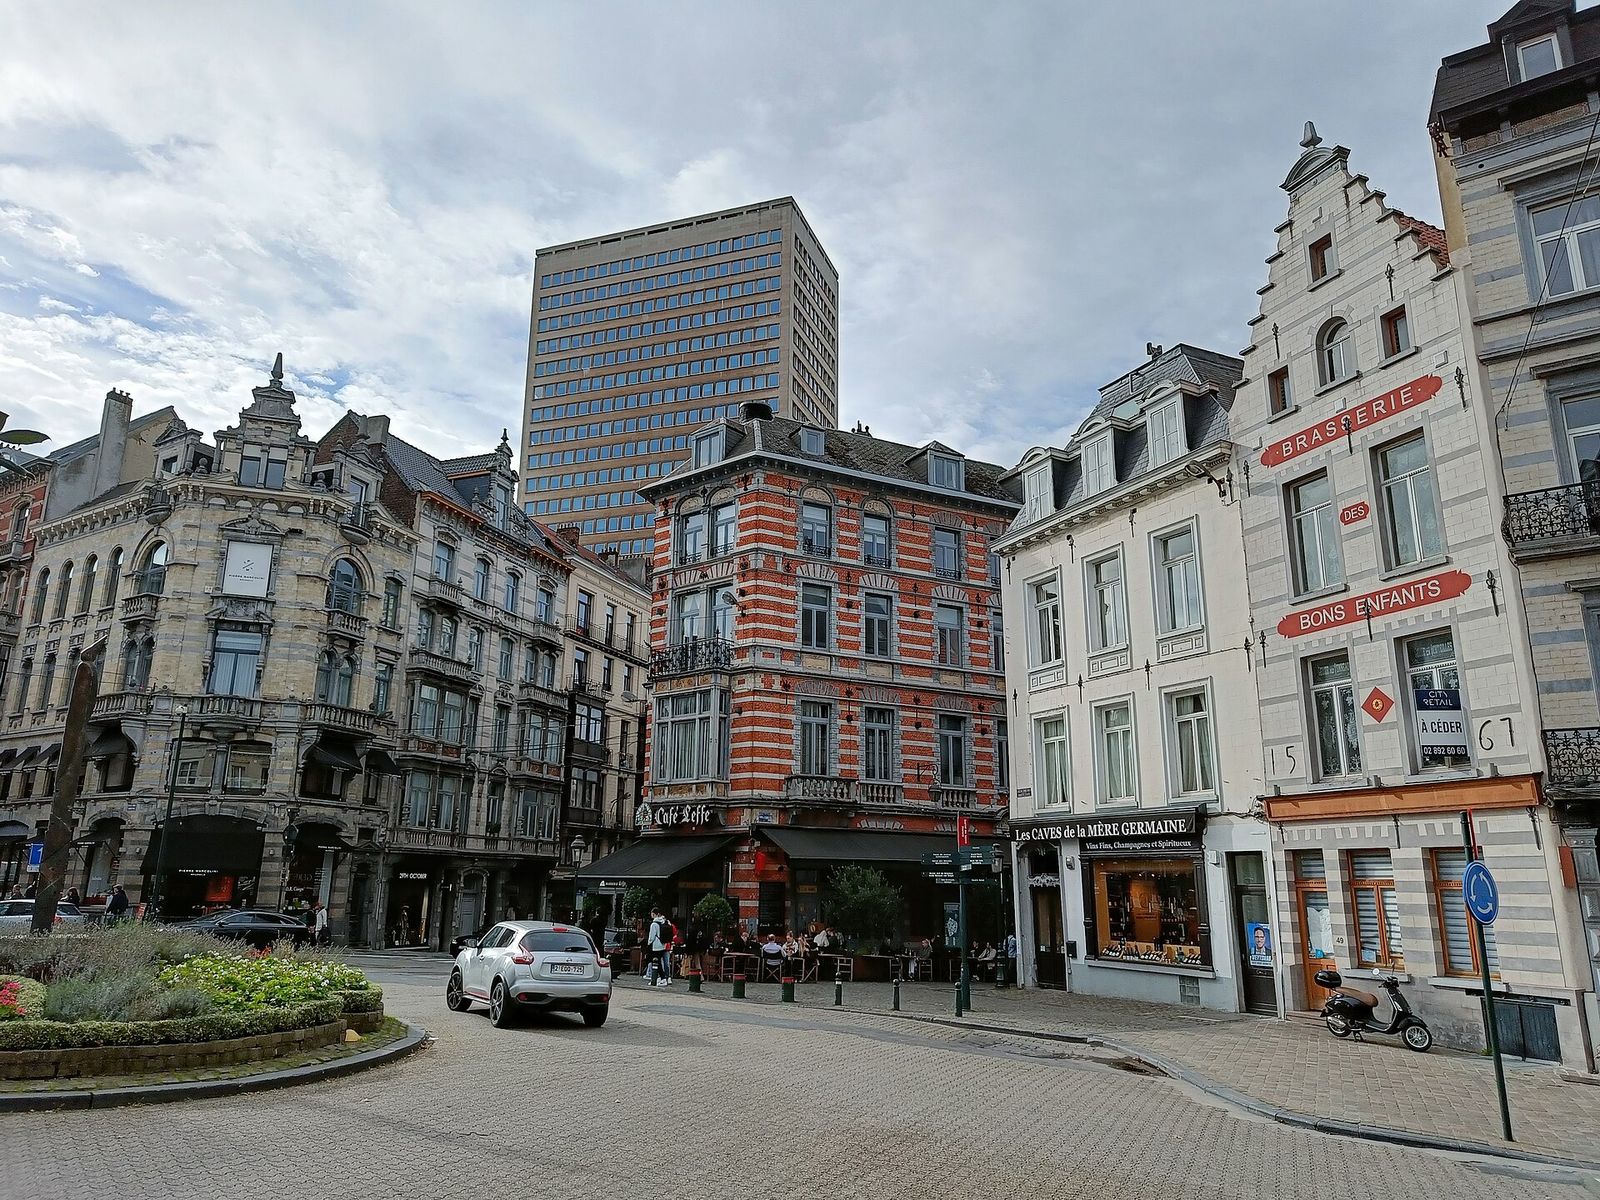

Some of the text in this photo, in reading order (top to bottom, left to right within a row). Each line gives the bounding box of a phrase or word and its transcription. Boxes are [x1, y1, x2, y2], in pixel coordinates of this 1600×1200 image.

[1282, 386, 1414, 457] BRASSERIE
[1344, 505, 1365, 521] DES
[1300, 579, 1441, 630] BONS ENFANTS
[1423, 698, 1453, 706] RETAIL
[1421, 718, 1462, 733] À CÉDER
[1479, 717, 1515, 750] 67
[1423, 746, 1466, 755] 02 892 60 60
[655, 804, 711, 826] Café Leffe
[1015, 819, 1187, 841] Les CAVES de la MÈRE GERMAINE
[1086, 842, 1099, 850] Vins
[1113, 841, 1151, 850] Champagnes
